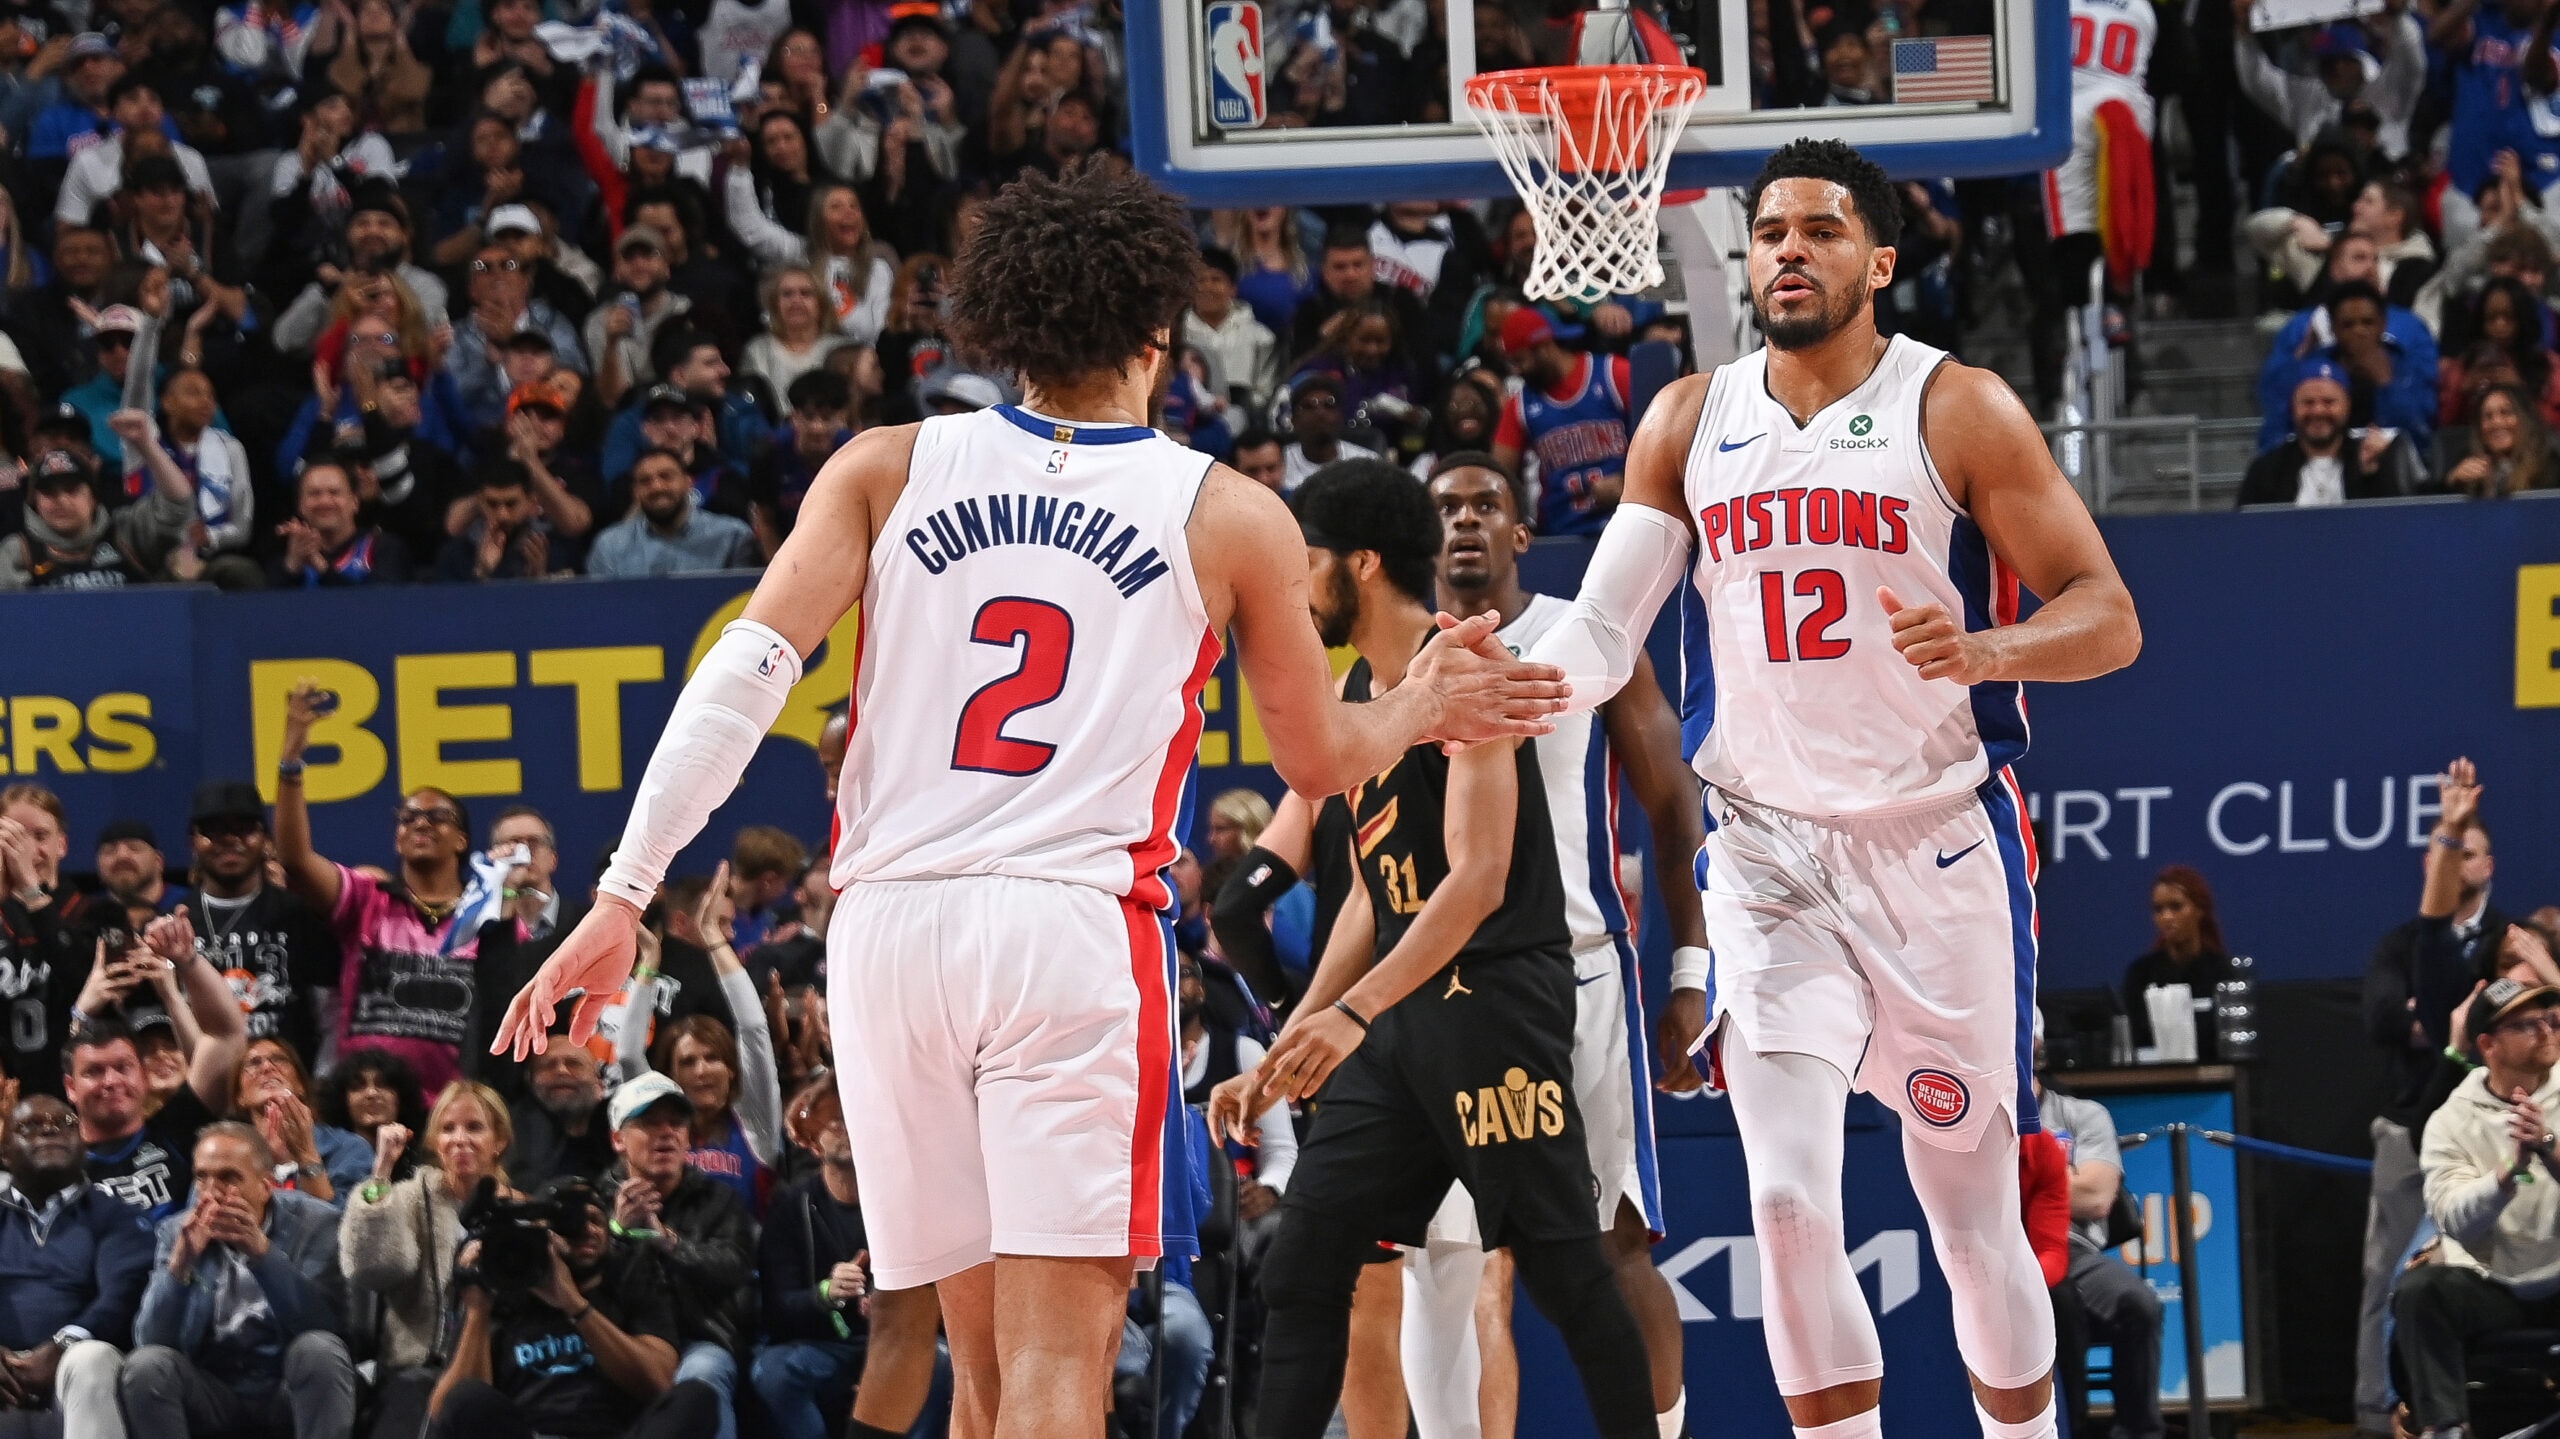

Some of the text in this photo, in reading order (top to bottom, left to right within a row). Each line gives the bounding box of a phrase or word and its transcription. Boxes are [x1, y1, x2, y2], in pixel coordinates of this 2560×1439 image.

[1218, 99, 1246, 119] NBA
[1829, 437, 1889, 450] StockX
[905, 493, 1170, 600] CUNNINGHAM
[1701, 487, 1909, 563] PISTONS
[1759, 569, 1852, 663] 12
[951, 596, 1075, 777] 2
[0, 692, 158, 776] RS
[2028, 786, 2173, 864] RT
[1380, 852, 1428, 914] 31
[1456, 1073, 1565, 1147] CAVS
[1917, 1090, 1956, 1112] PISTONS
[1918, 1082, 1957, 1102] DETROIT
